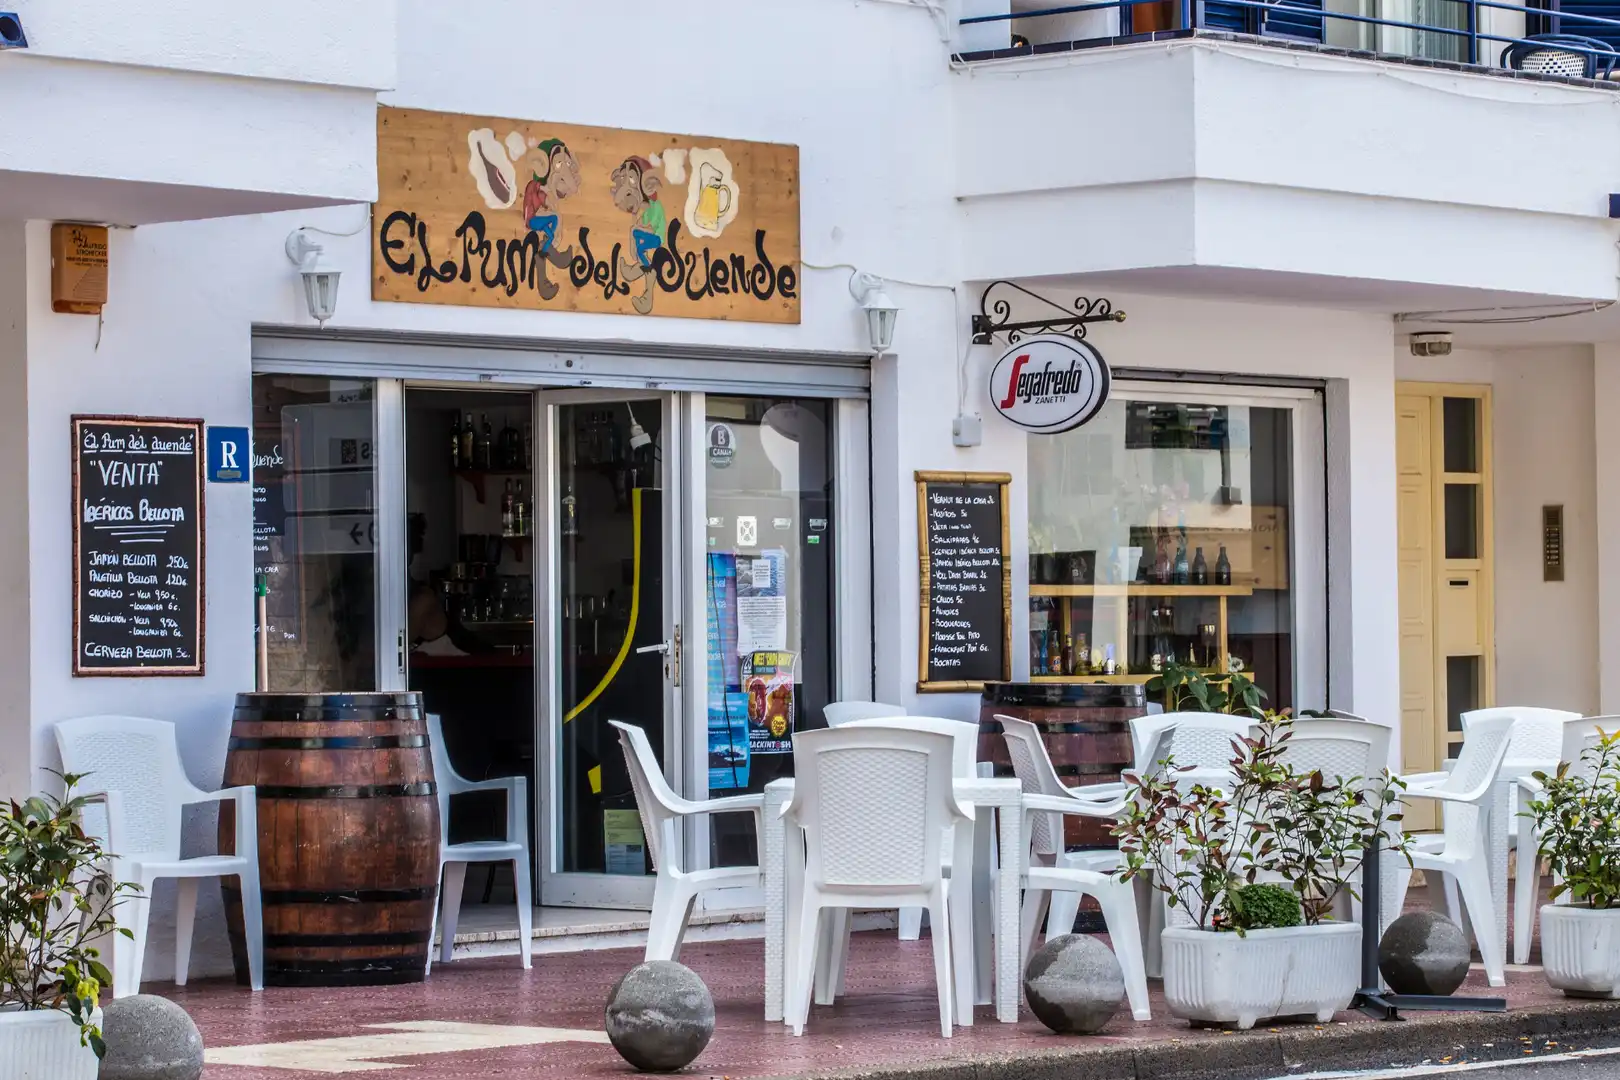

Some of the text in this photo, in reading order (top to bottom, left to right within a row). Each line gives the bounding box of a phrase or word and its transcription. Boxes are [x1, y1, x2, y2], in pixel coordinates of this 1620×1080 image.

[1000, 354, 1083, 409] Segafredo
[1035, 395, 1066, 405] ZANETTI
[220, 440, 240, 469] R
[83, 497, 134, 523] IBÉRICOS
[122, 553, 157, 567] BELLOTA
[127, 571, 158, 585] BELLOTA
[84, 641, 133, 659] CERVEZA
[135, 645, 173, 659] BELLOTA
